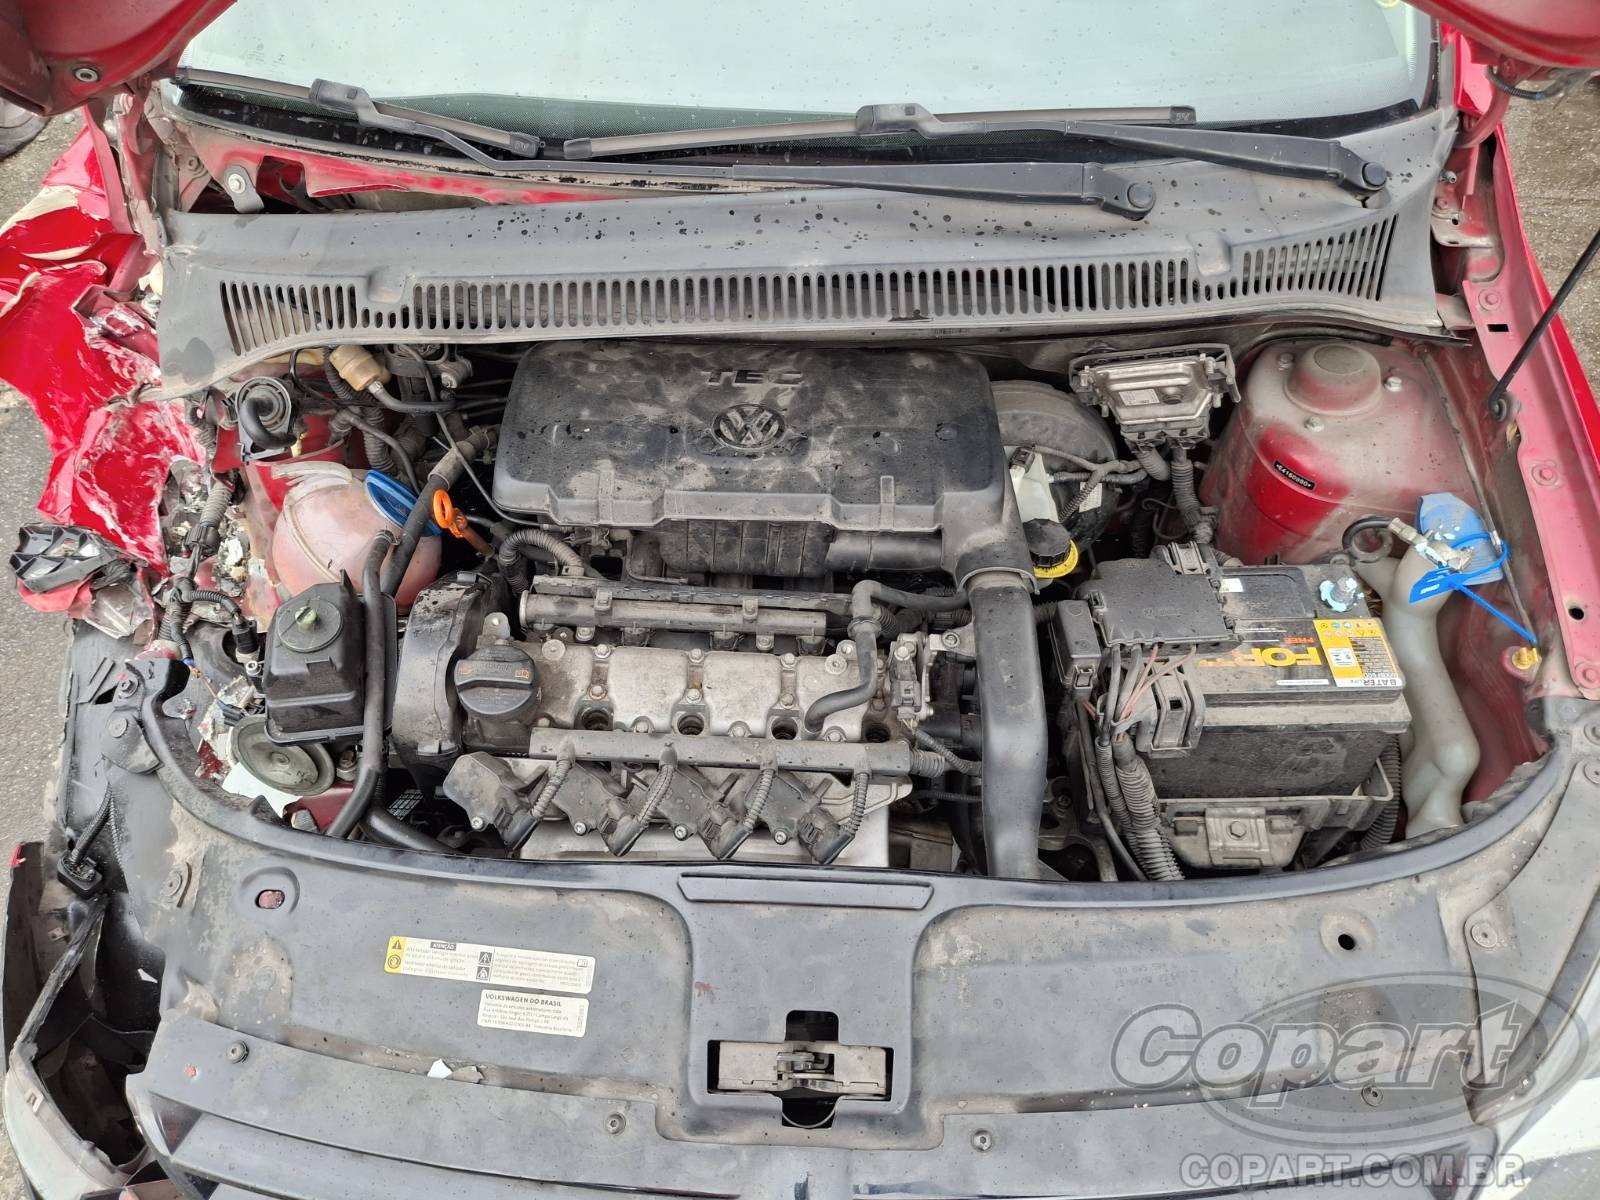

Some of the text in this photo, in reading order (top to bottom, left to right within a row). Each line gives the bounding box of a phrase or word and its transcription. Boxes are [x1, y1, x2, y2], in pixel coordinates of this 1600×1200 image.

[485, 992, 529, 1004] VOLKSWAGEN
[529, 997, 540, 1005] DO
[540, 999, 561, 1008] BRASIL
